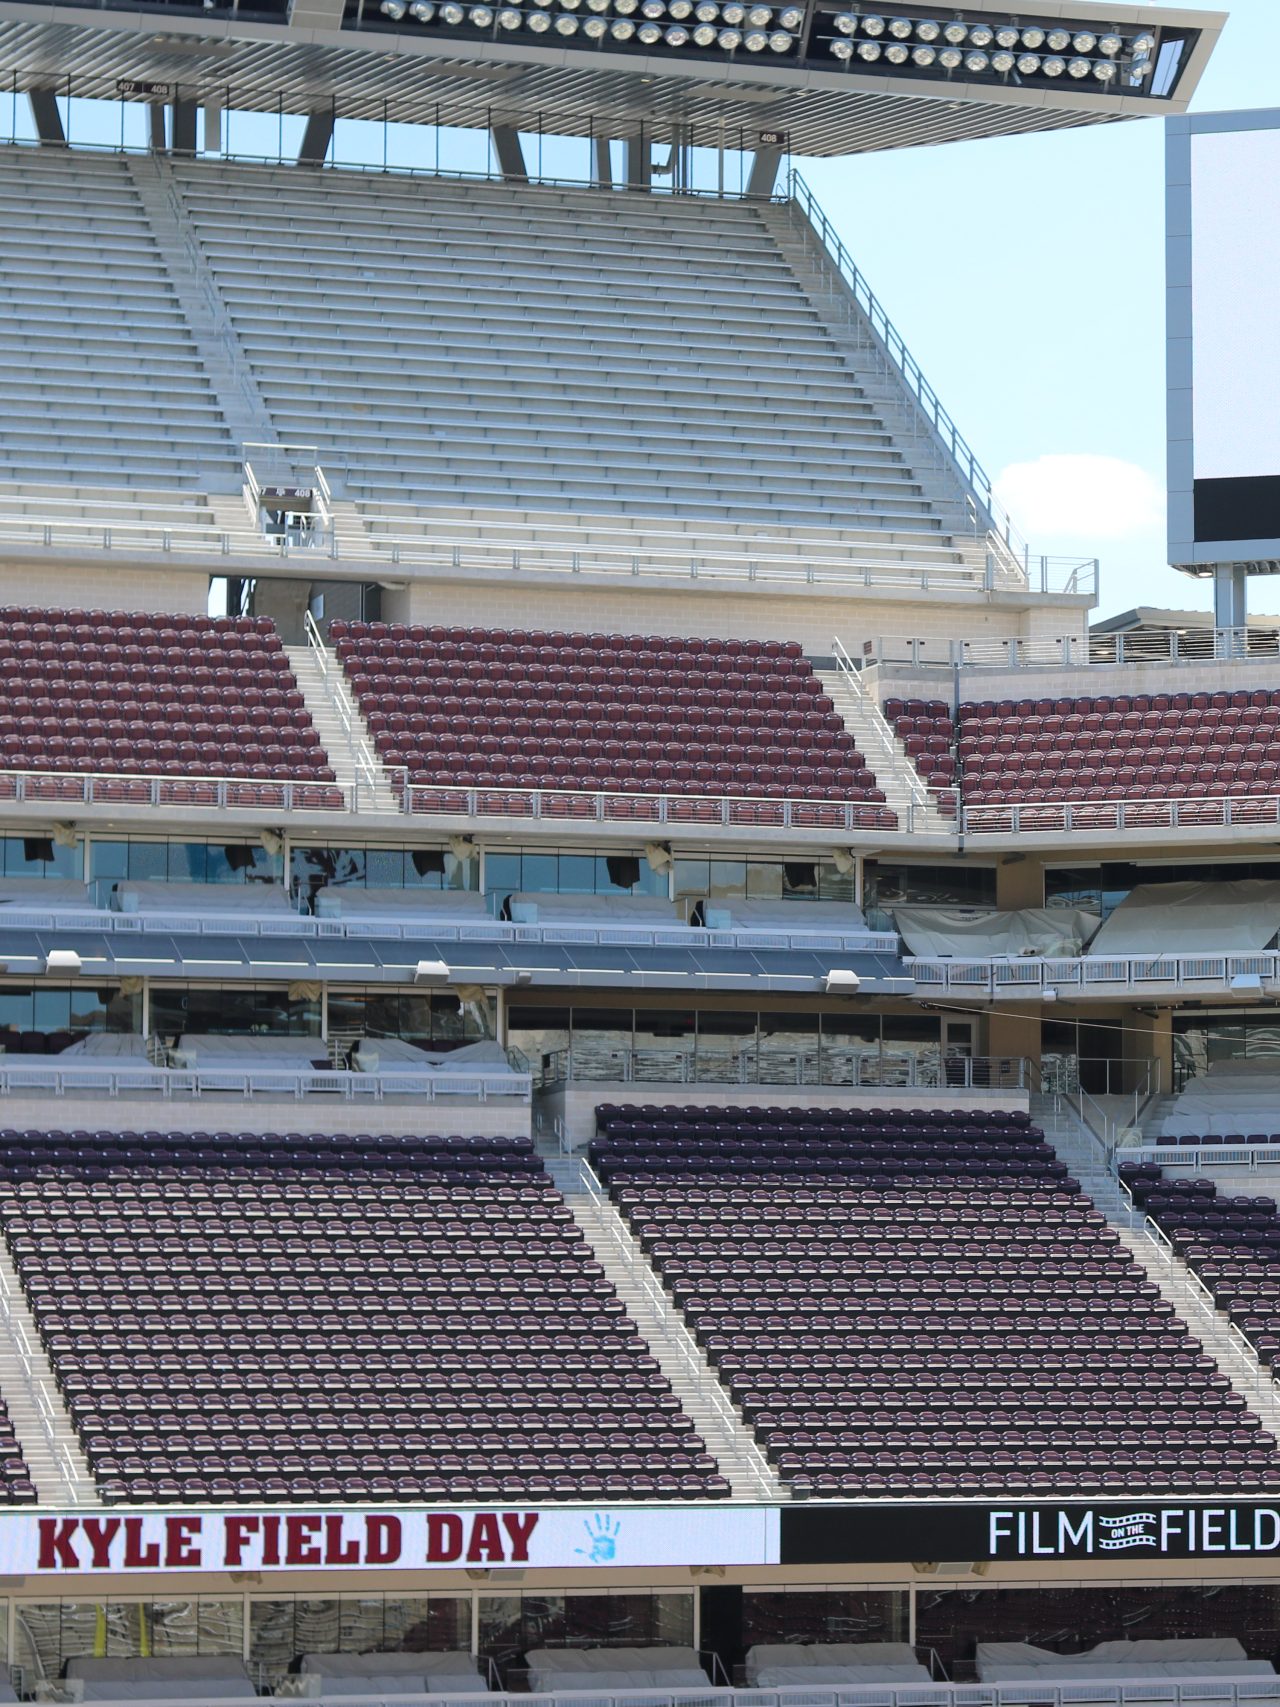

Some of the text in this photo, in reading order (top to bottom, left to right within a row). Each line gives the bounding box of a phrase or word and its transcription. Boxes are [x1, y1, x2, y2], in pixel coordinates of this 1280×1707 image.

[118, 82, 168, 94] 407 408
[761, 133, 777, 143] 408
[37, 1512, 539, 1569] KYLE FIELD DAY
[989, 1509, 1280, 1555] FILM ON THE FIELD
